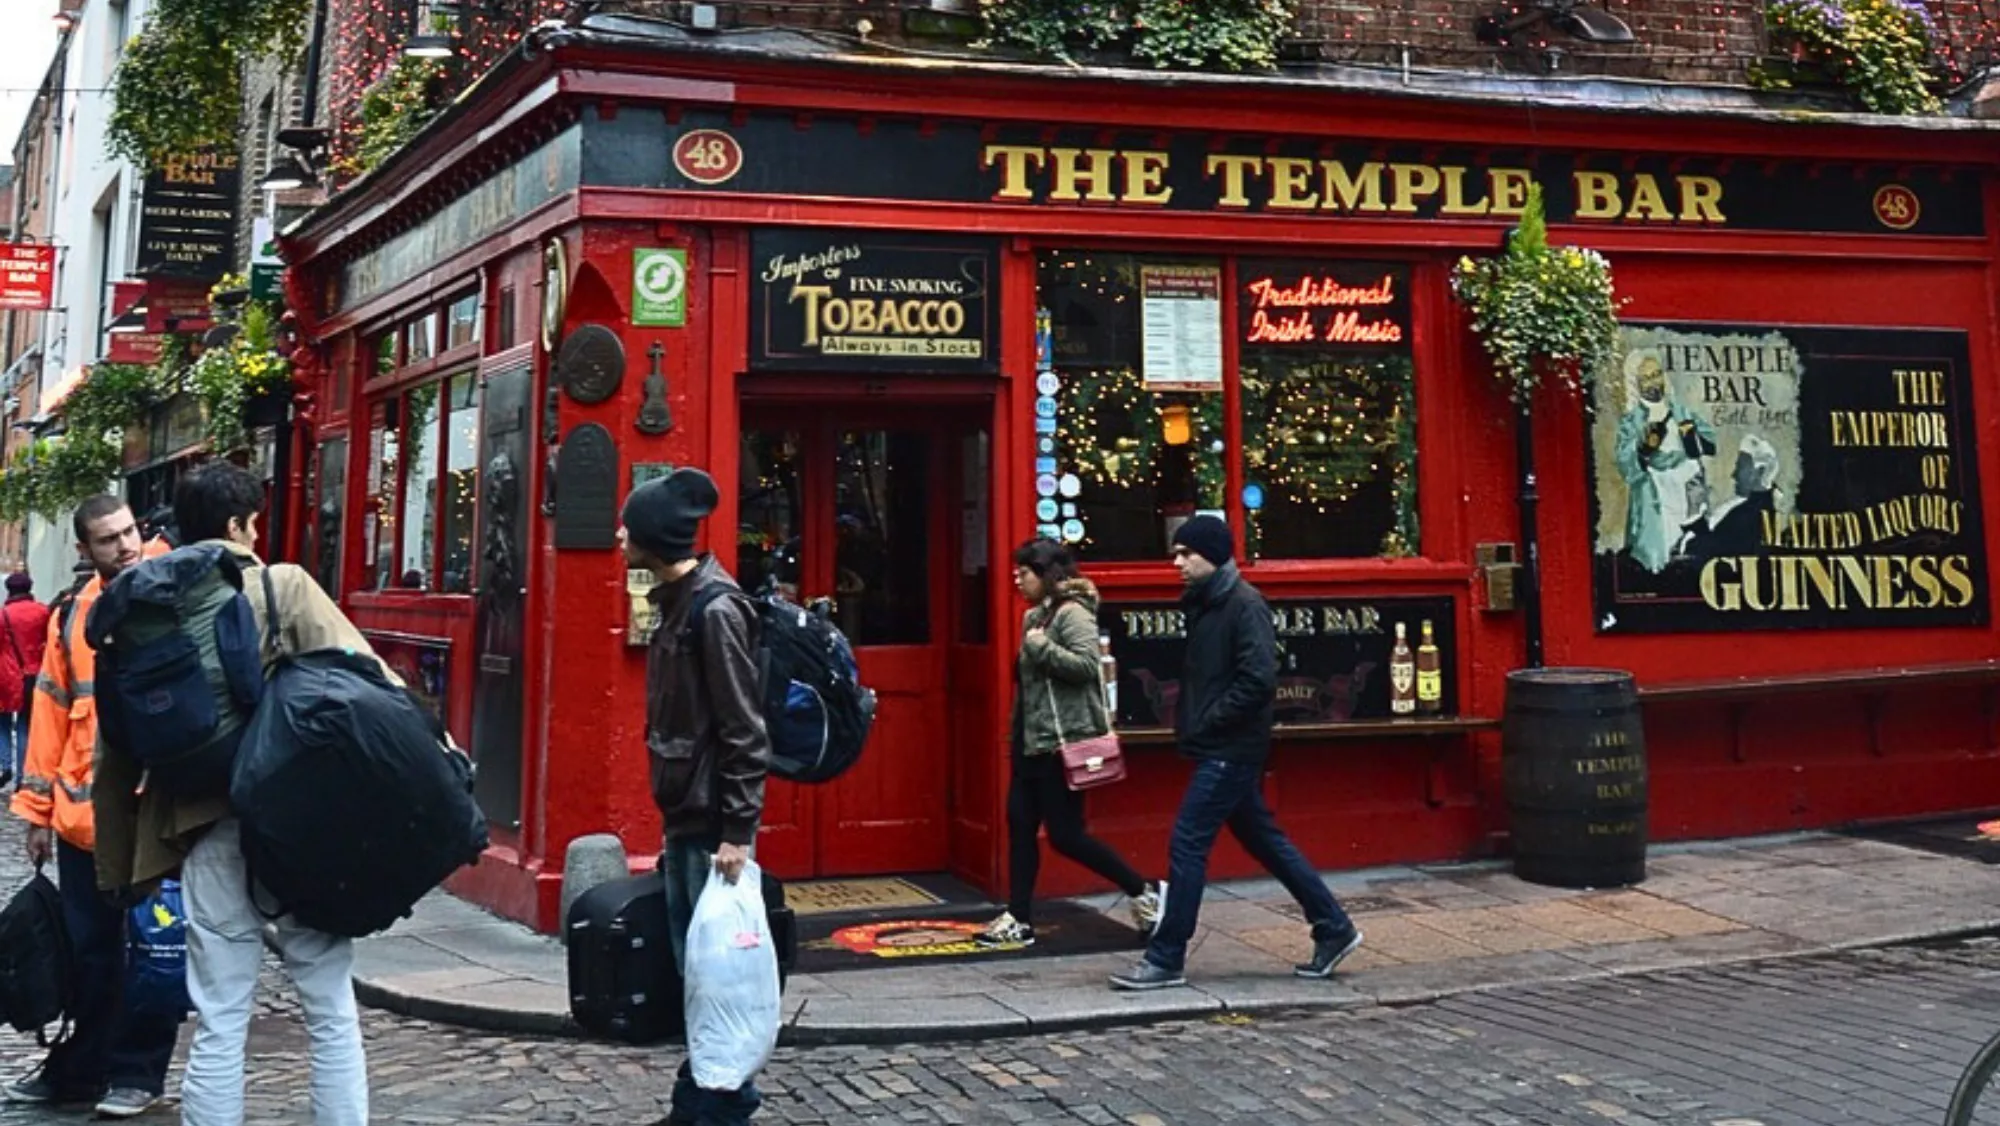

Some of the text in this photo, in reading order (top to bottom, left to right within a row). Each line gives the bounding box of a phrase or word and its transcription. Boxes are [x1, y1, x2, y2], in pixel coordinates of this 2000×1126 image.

[684, 135, 728, 170] 48
[164, 165, 215, 185] BAR
[986, 145, 1726, 222] THE TEMPLE BAR
[144, 206, 232, 219] BEER GARDEN
[1880, 192, 1909, 218] 48
[13, 247, 39, 258] THE
[147, 241, 223, 254] LIVE MUSIC
[0, 259, 50, 273] TEMPLE
[9, 271, 37, 283] BAR
[761, 245, 861, 283] Importers
[850, 275, 964, 294] FINE SMOKING
[1250, 275, 1394, 308] Traditional
[789, 285, 965, 346] TOBACCO
[1247, 310, 1315, 342] Irish
[1326, 311, 1402, 342] Music
[824, 337, 978, 354] Always in Stock
[1660, 344, 1791, 373] TEMPLE
[1702, 375, 1767, 406] BAR
[1892, 371, 1945, 405] THE
[1831, 411, 1948, 447] EMPEROR
[1922, 455, 1949, 489] OF
[1761, 493, 1964, 549] MALTED LIQUORS
[1699, 554, 1974, 611] GUINNESS
[1121, 609, 1187, 639] THE
[1323, 606, 1384, 634] BAR
[1276, 685, 1317, 700] DAILY
[1597, 783, 1634, 800] BAR
